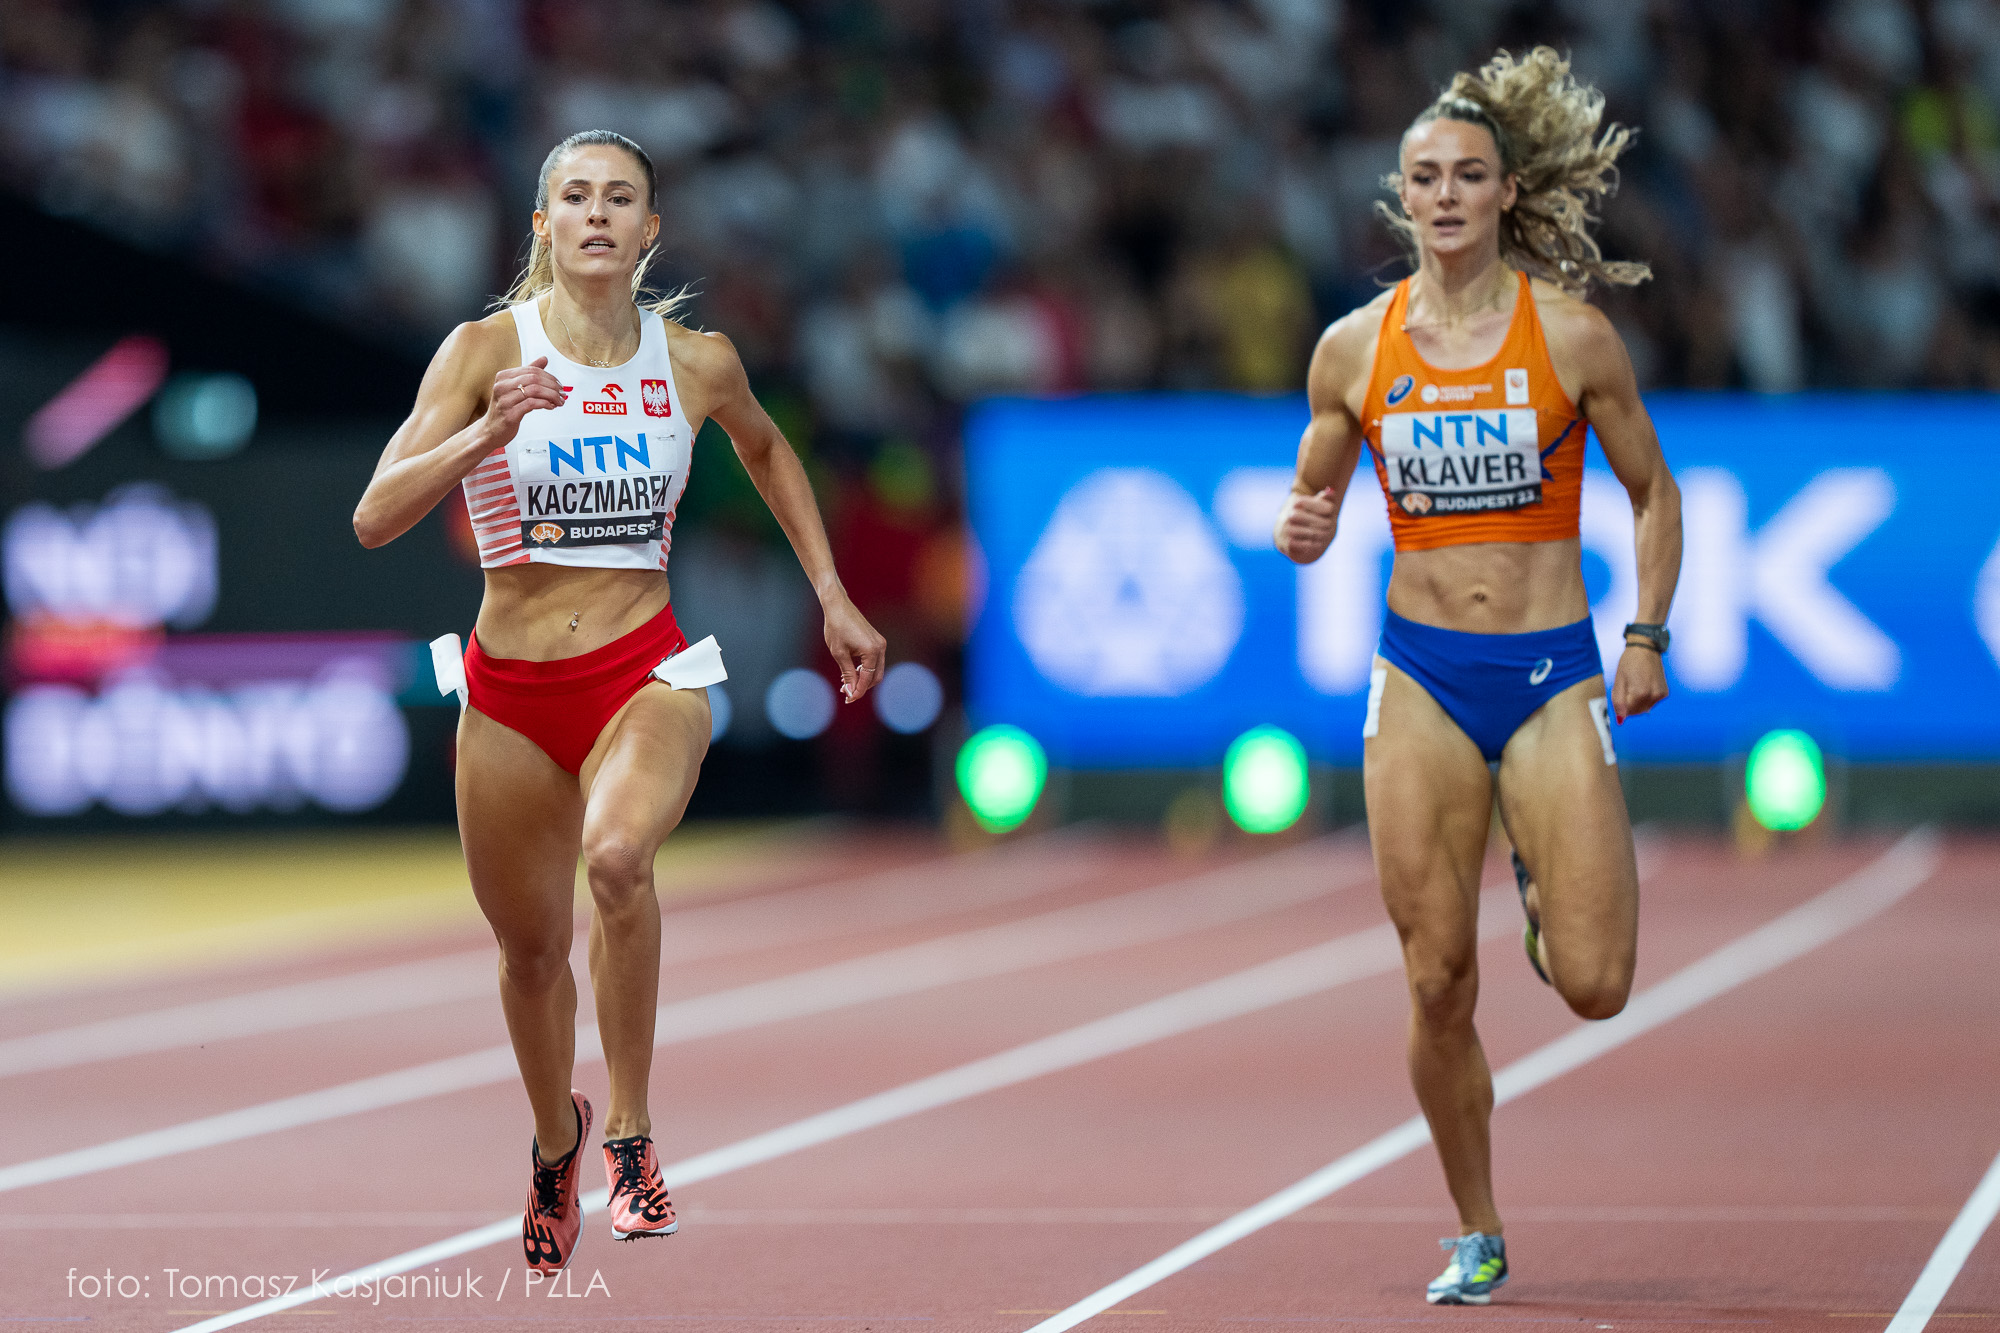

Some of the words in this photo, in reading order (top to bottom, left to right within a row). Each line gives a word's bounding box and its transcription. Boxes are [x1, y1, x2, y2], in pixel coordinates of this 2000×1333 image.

[585, 403, 625, 414] ORLEN
[1413, 413, 1508, 449] NTN
[548, 433, 651, 477] NTN
[1398, 452, 1526, 487] KLAVER
[527, 475, 672, 516] KACZMAREK
[1435, 493, 1516, 510] BUDAPEST
